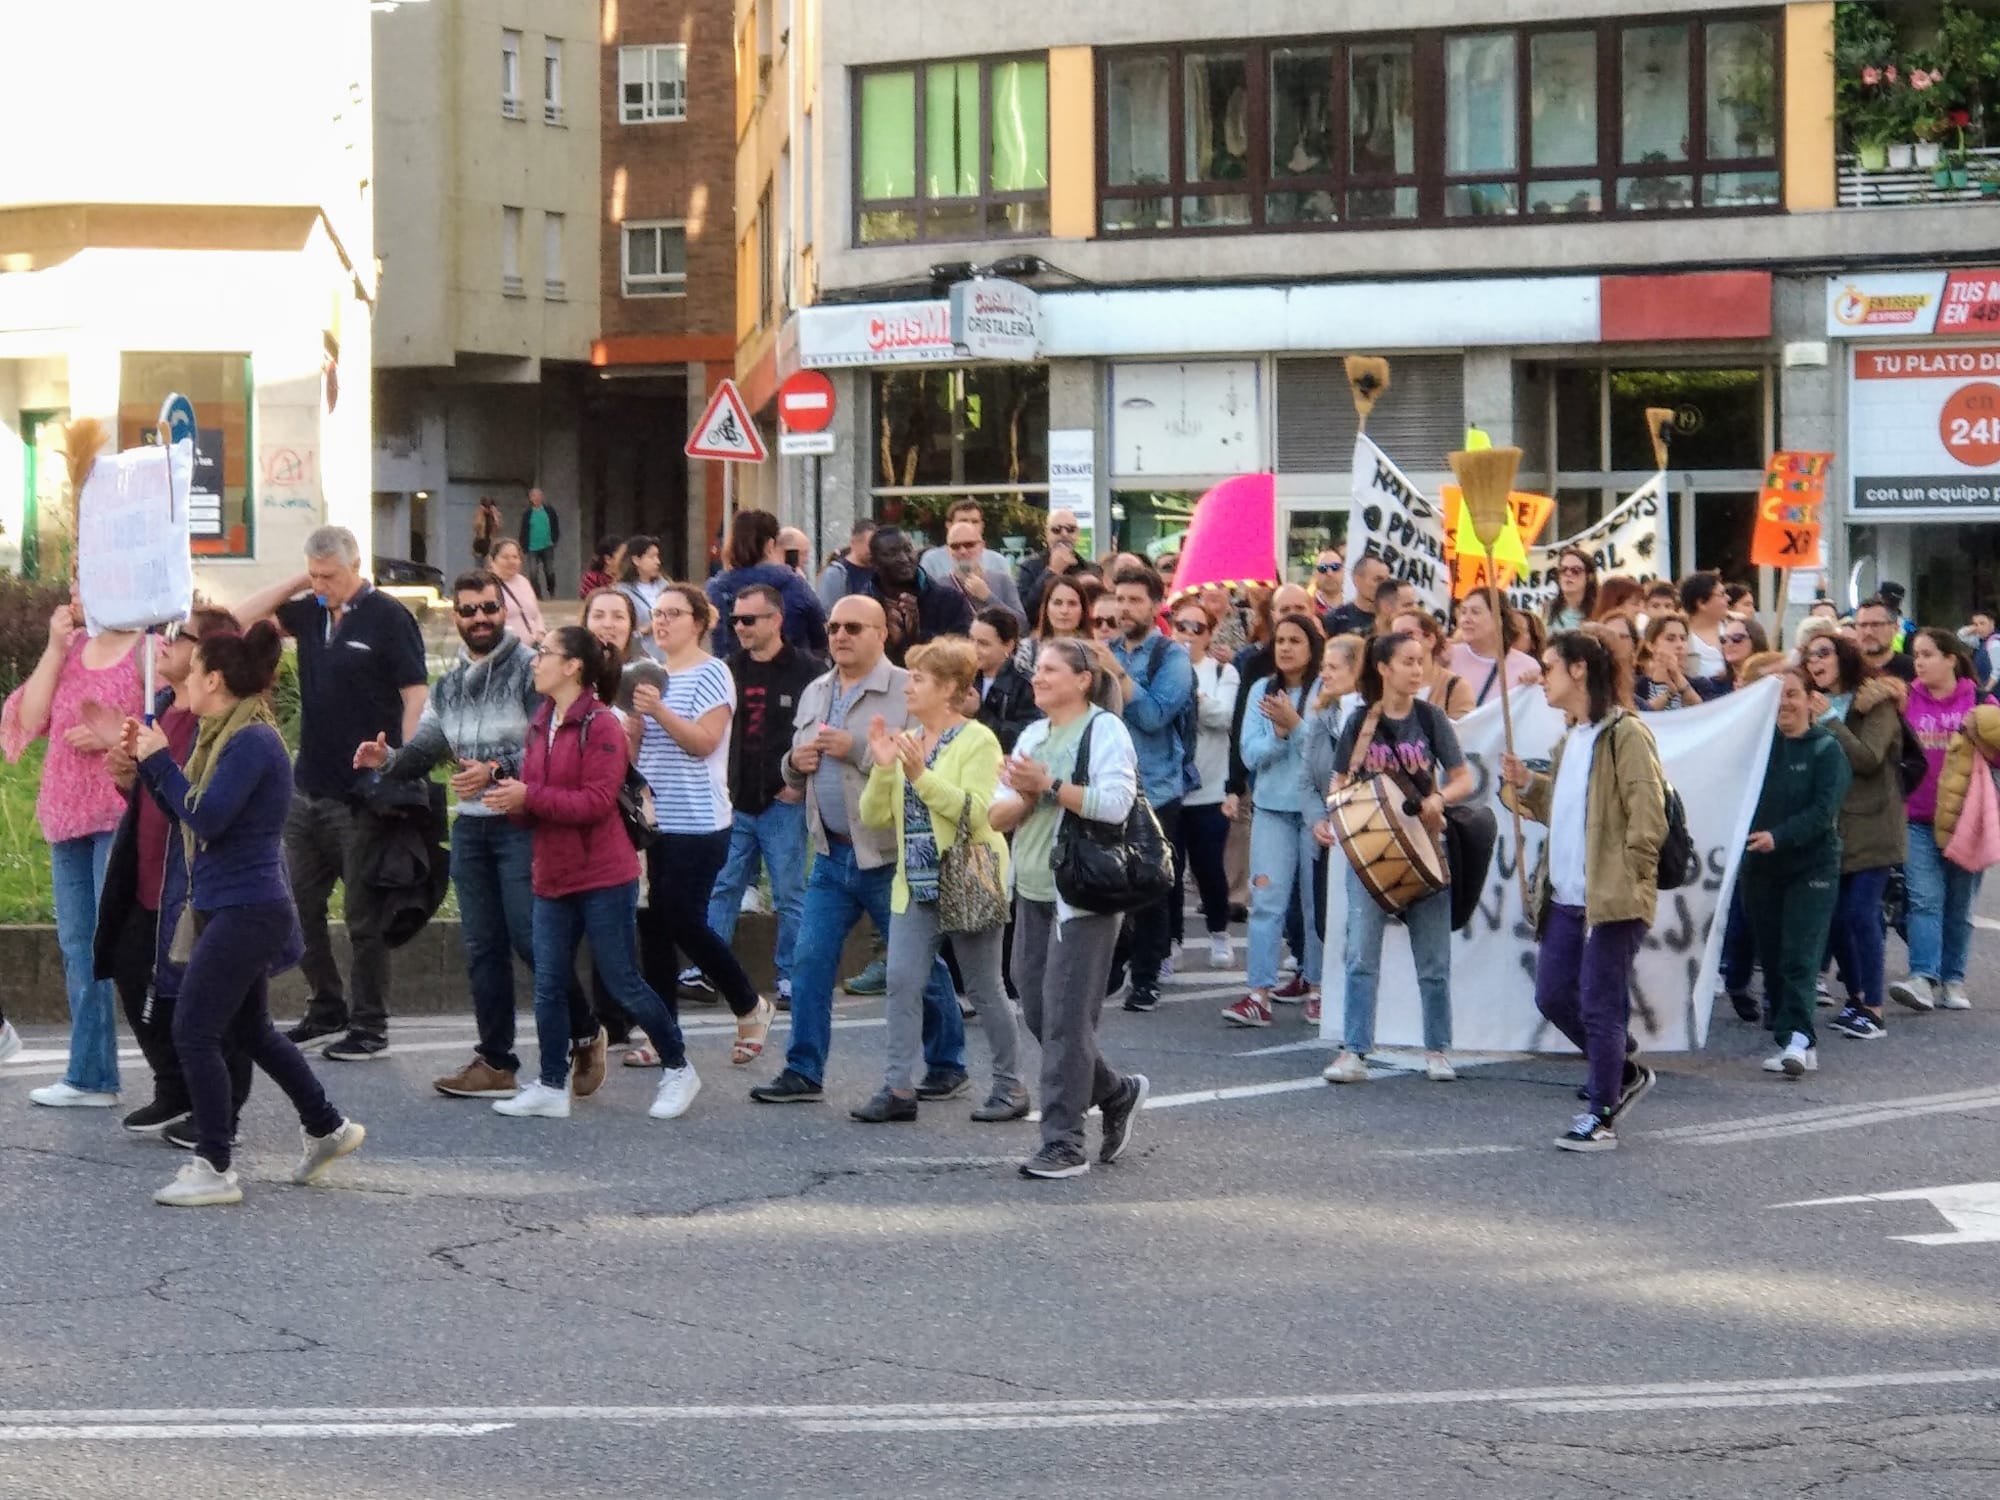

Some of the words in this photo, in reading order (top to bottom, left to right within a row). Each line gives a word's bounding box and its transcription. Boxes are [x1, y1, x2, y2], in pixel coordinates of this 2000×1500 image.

[1950, 281, 1986, 303] TUS
[1943, 303, 1970, 325] EN
[1873, 355, 1901, 373] TU
[1905, 353, 1976, 373] PLATO
[1865, 488, 1899, 501] con
[1902, 487, 1925, 501] un
[1927, 484, 1990, 503] equipo
[1363, 504, 1382, 532] O
